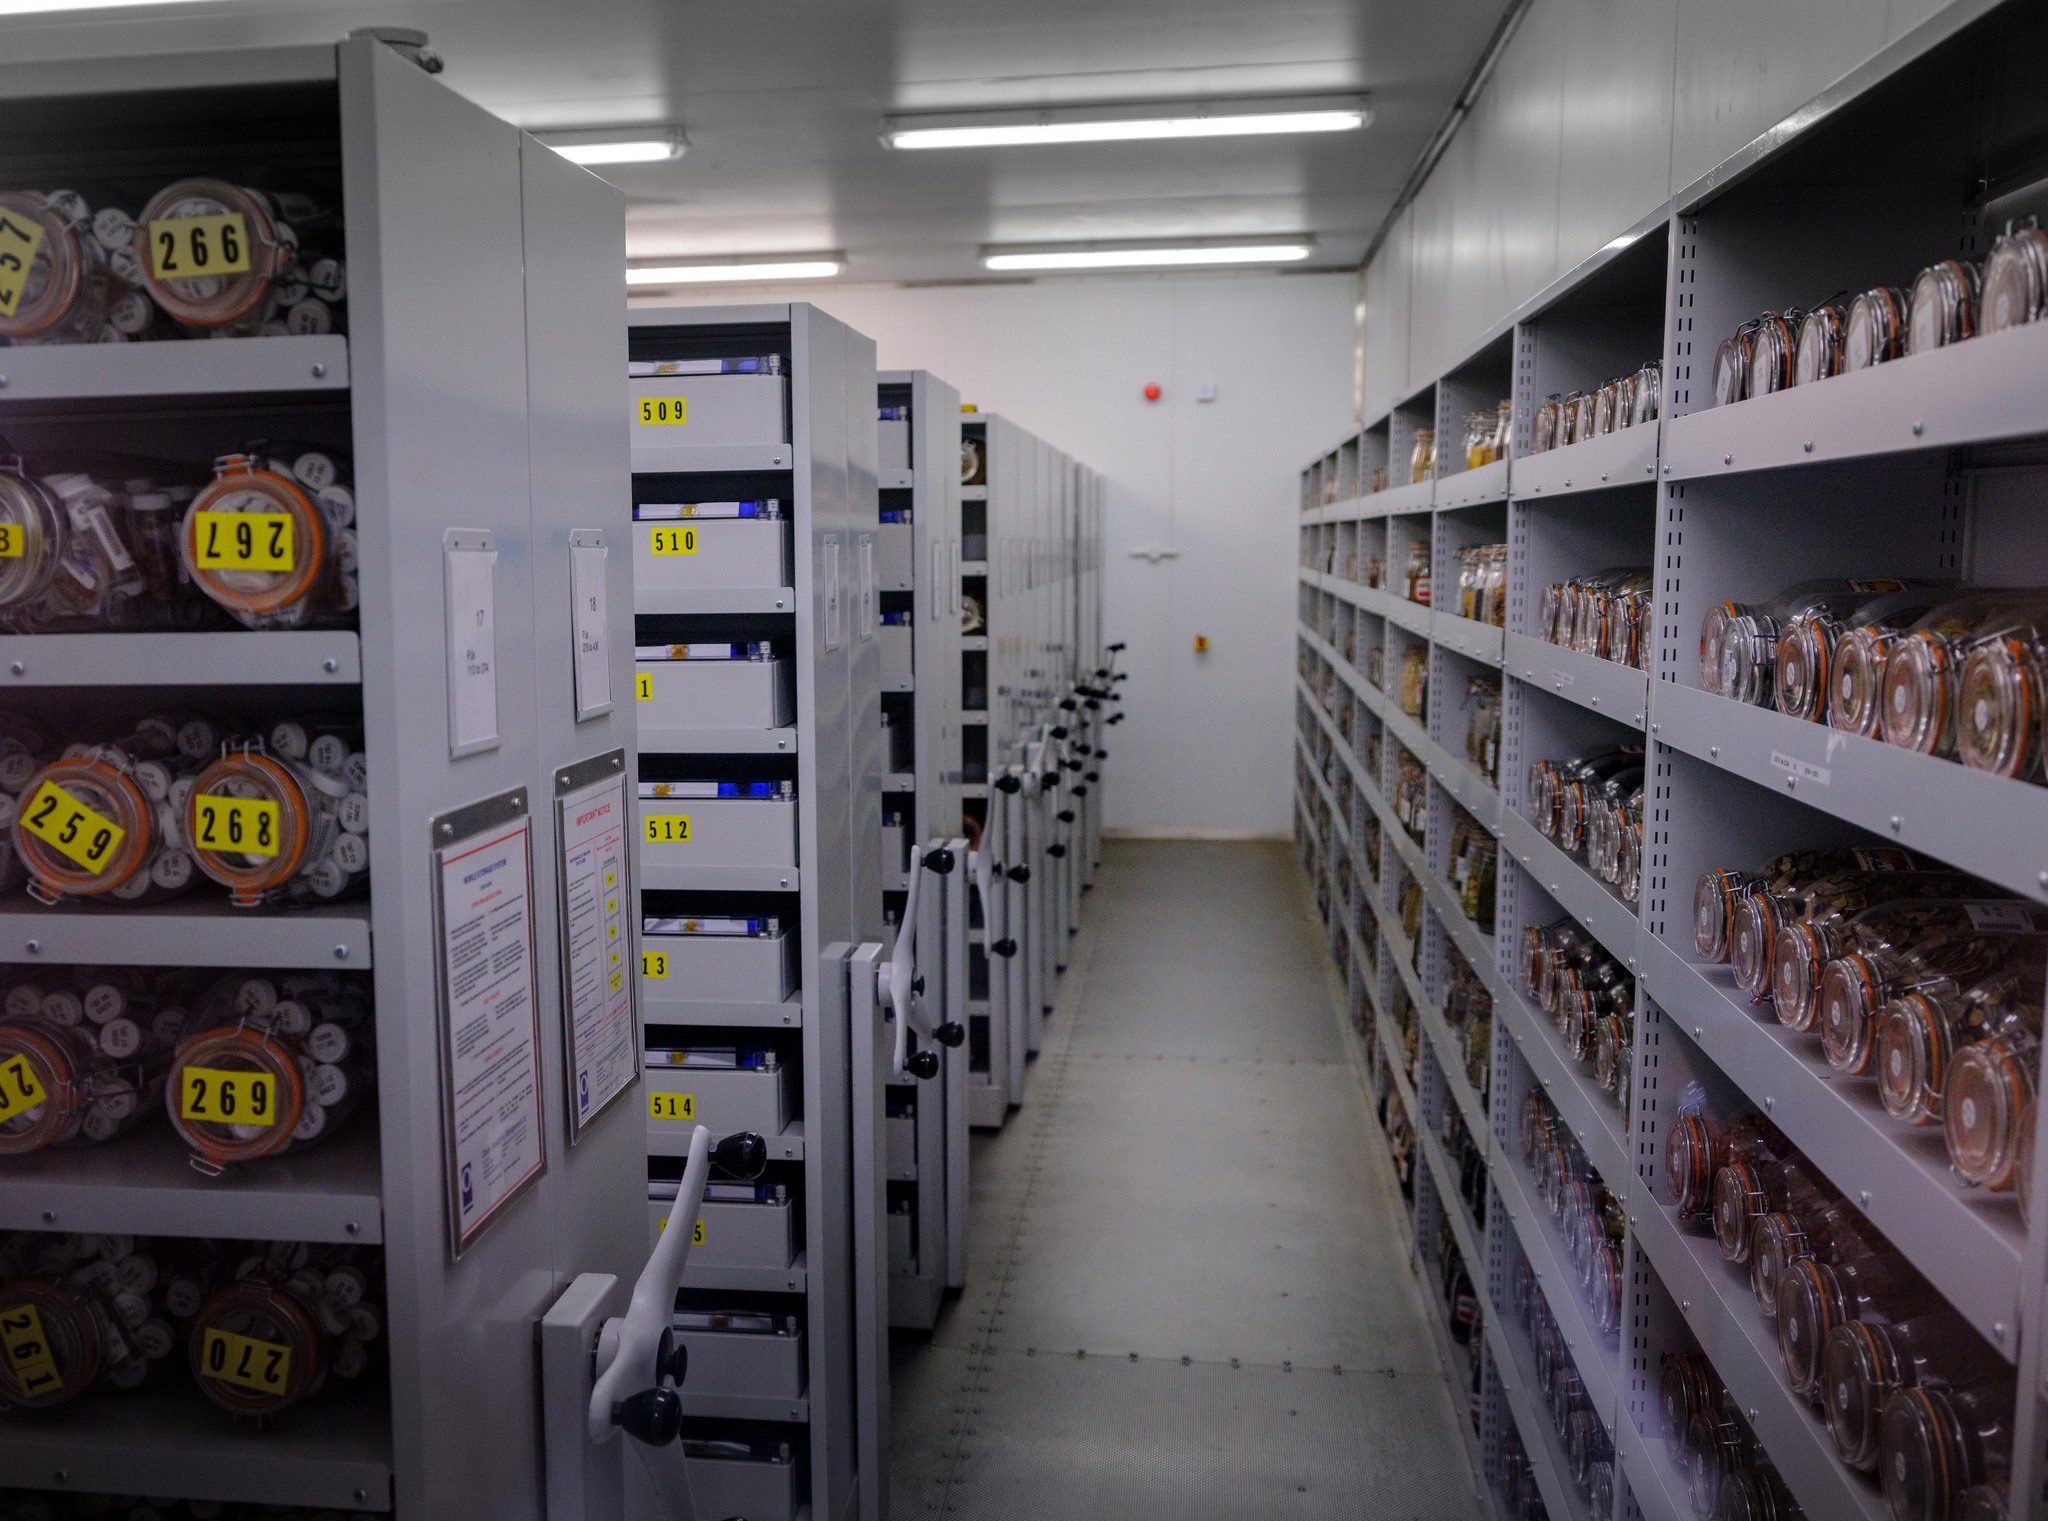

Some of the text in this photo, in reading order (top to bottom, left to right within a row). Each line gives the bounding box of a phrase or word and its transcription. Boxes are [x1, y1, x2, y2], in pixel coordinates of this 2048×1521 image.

[159, 224, 240, 271] 266
[643, 400, 682, 421] 509
[206, 521, 284, 560] 267
[655, 531, 694, 552] 510
[29, 795, 112, 861] 259
[201, 806, 271, 851] 268
[649, 820, 688, 840] 512
[642, 957, 665, 975] 13
[190, 1078, 267, 1116] 269
[654, 1096, 692, 1116] 514
[2, 1313, 55, 1391] 261
[208, 1337, 285, 1385] 270
